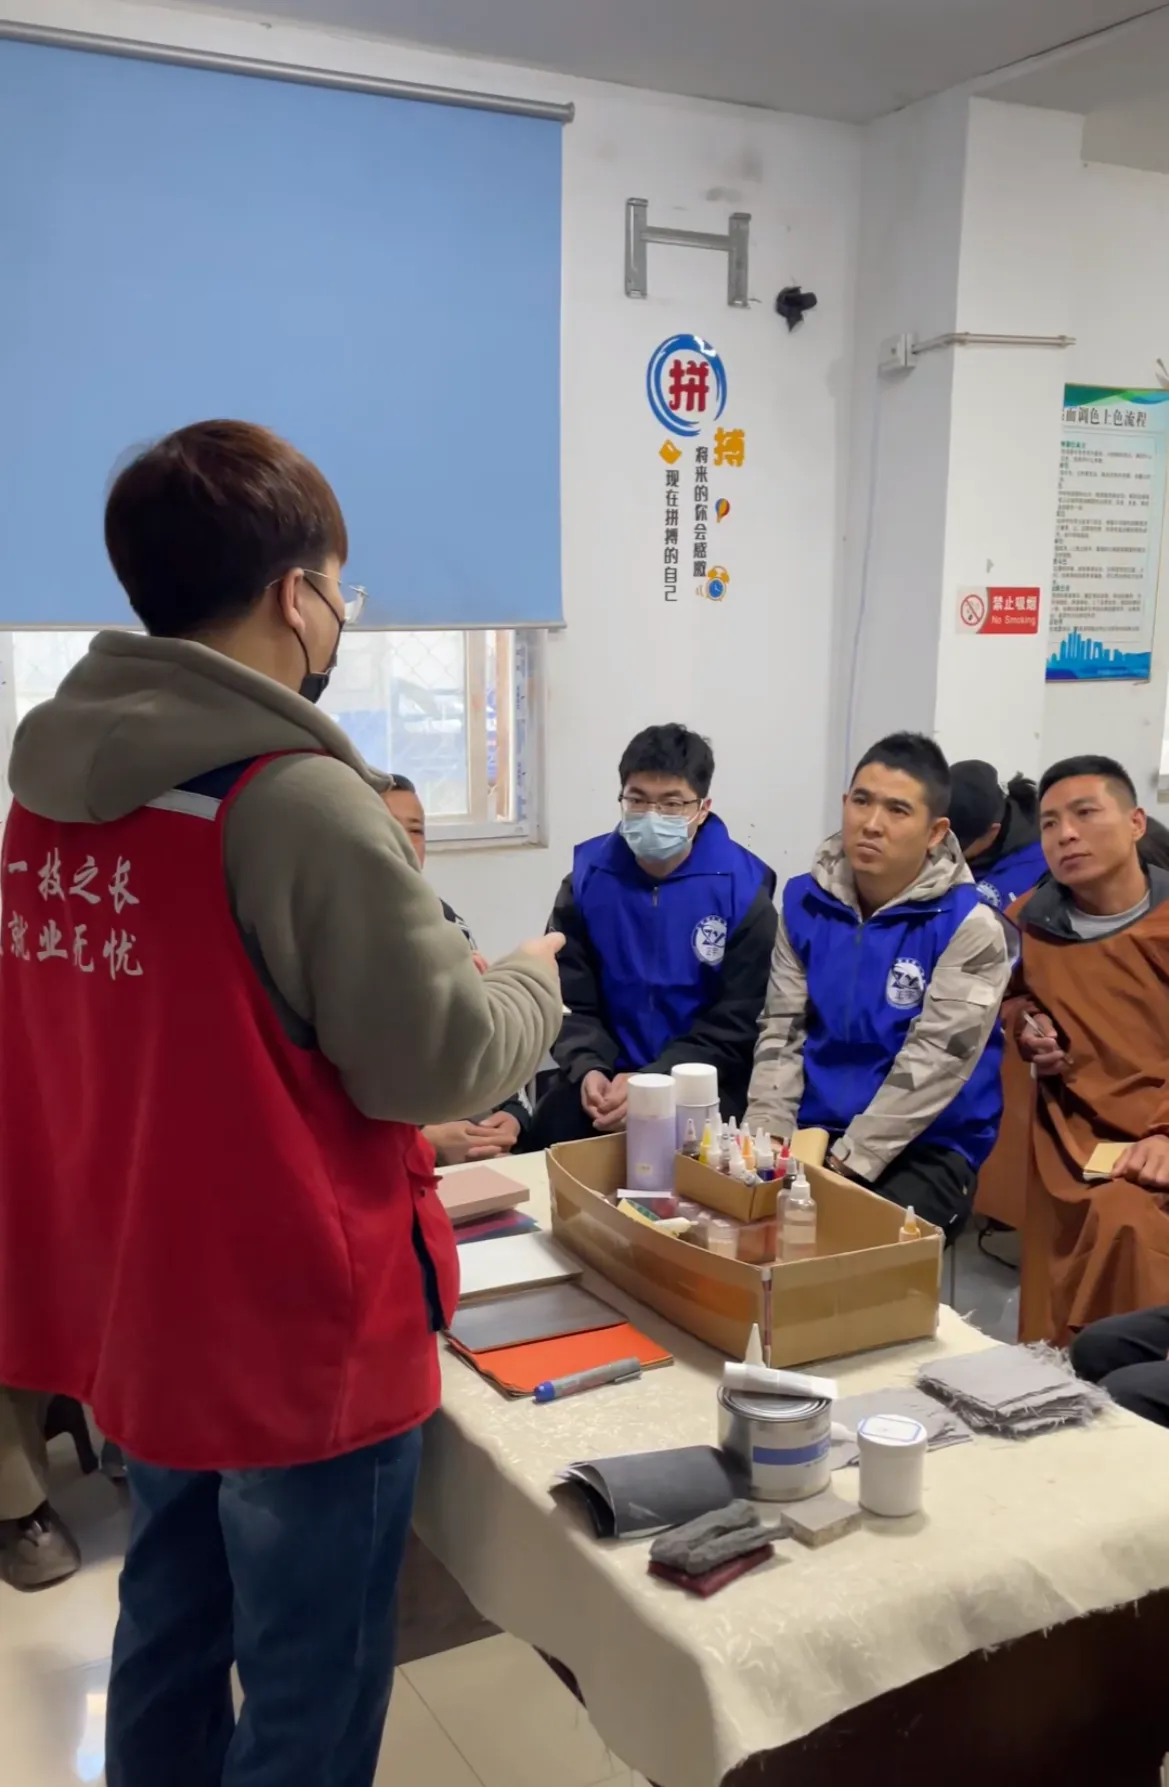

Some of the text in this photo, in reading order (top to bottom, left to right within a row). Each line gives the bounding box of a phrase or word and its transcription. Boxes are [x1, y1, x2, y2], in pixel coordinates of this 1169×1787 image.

[668, 359, 709, 411] 拼
[1062, 407, 1147, 427] 面调色上色流程
[714, 427, 743, 467] 搏
[664, 470, 679, 601] 现在拼搏的自己
[693, 446, 708, 577] 将来的你会感激
[991, 615, 1036, 627] No Smoking
[8, 847, 140, 914] 一技之长
[8, 910, 144, 981] 就业无忧
